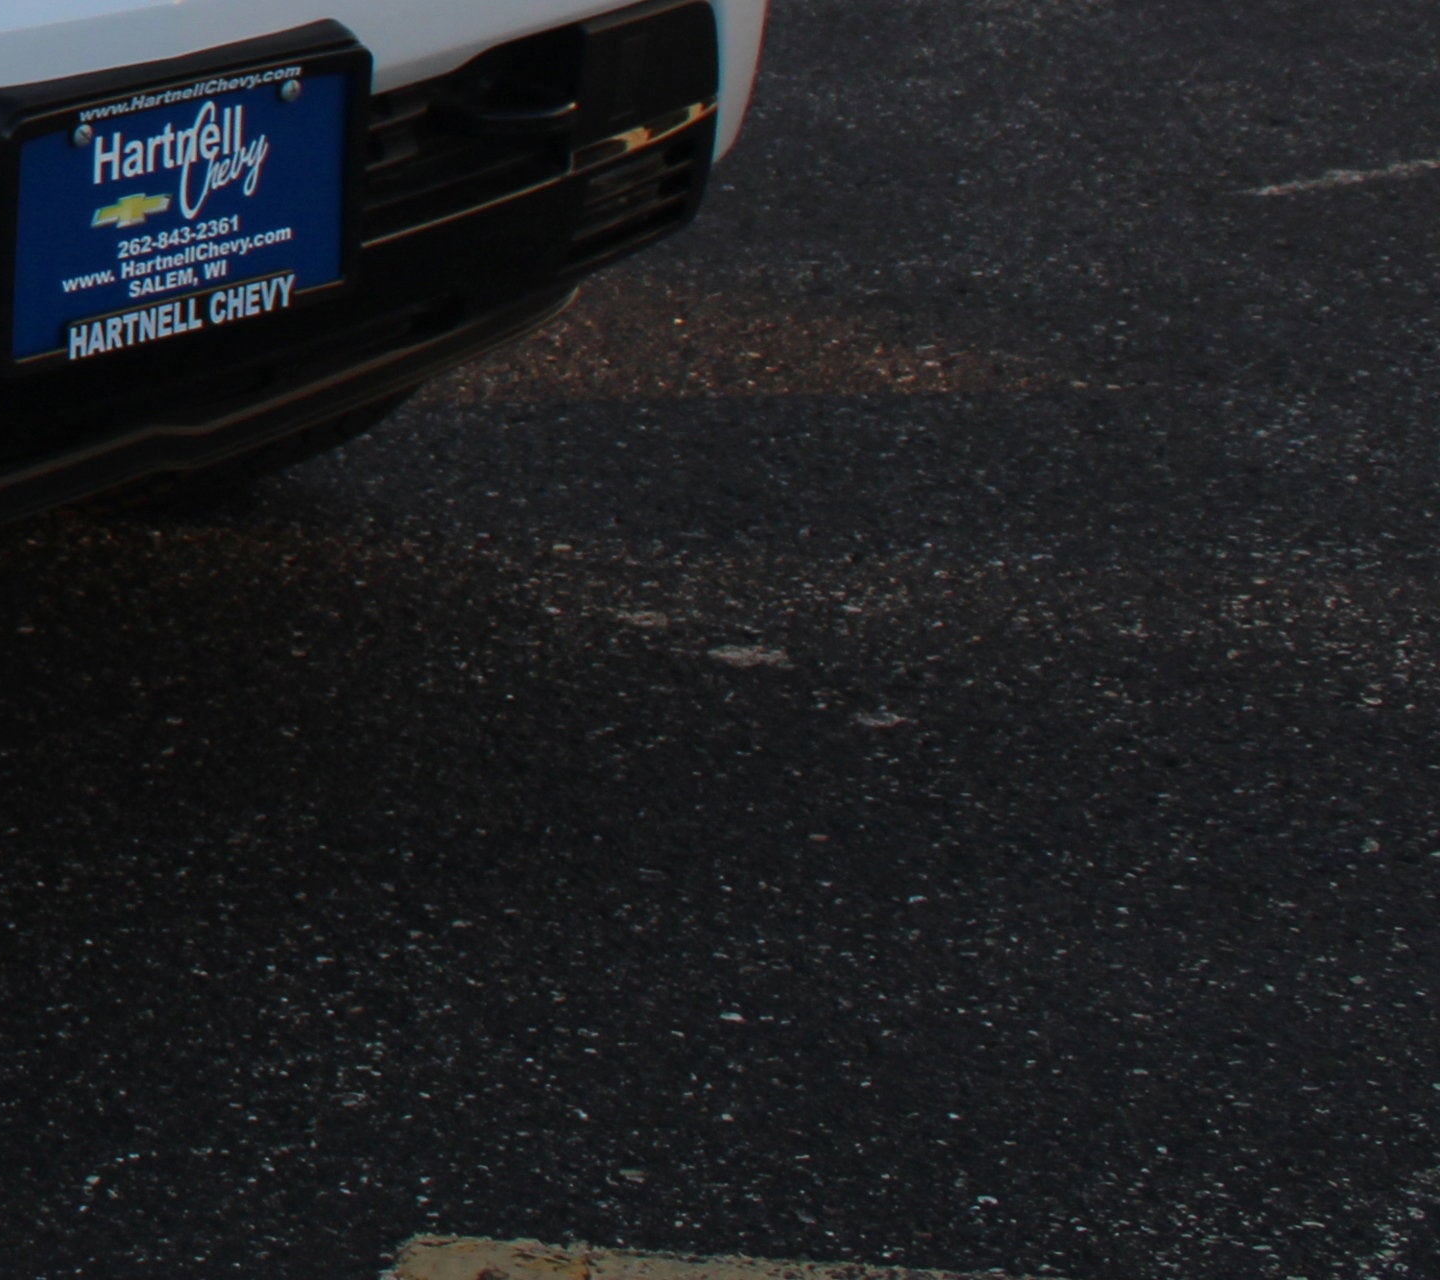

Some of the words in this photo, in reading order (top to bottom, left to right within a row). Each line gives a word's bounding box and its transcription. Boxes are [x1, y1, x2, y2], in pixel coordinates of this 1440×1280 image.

[79, 65, 302, 123] www.HartnellChevy.com
[92, 104, 244, 185] Hartnell
[180, 100, 269, 220] Chevy
[61, 268, 115, 293] www.
[120, 226, 292, 280] HartnellChevy.com
[116, 213, 240, 260] 262-843-2361
[128, 268, 199, 298] SALEM,
[203, 259, 228, 281] WI
[68, 297, 203, 361] HARTNELL
[208, 273, 296, 325] CHEVY
